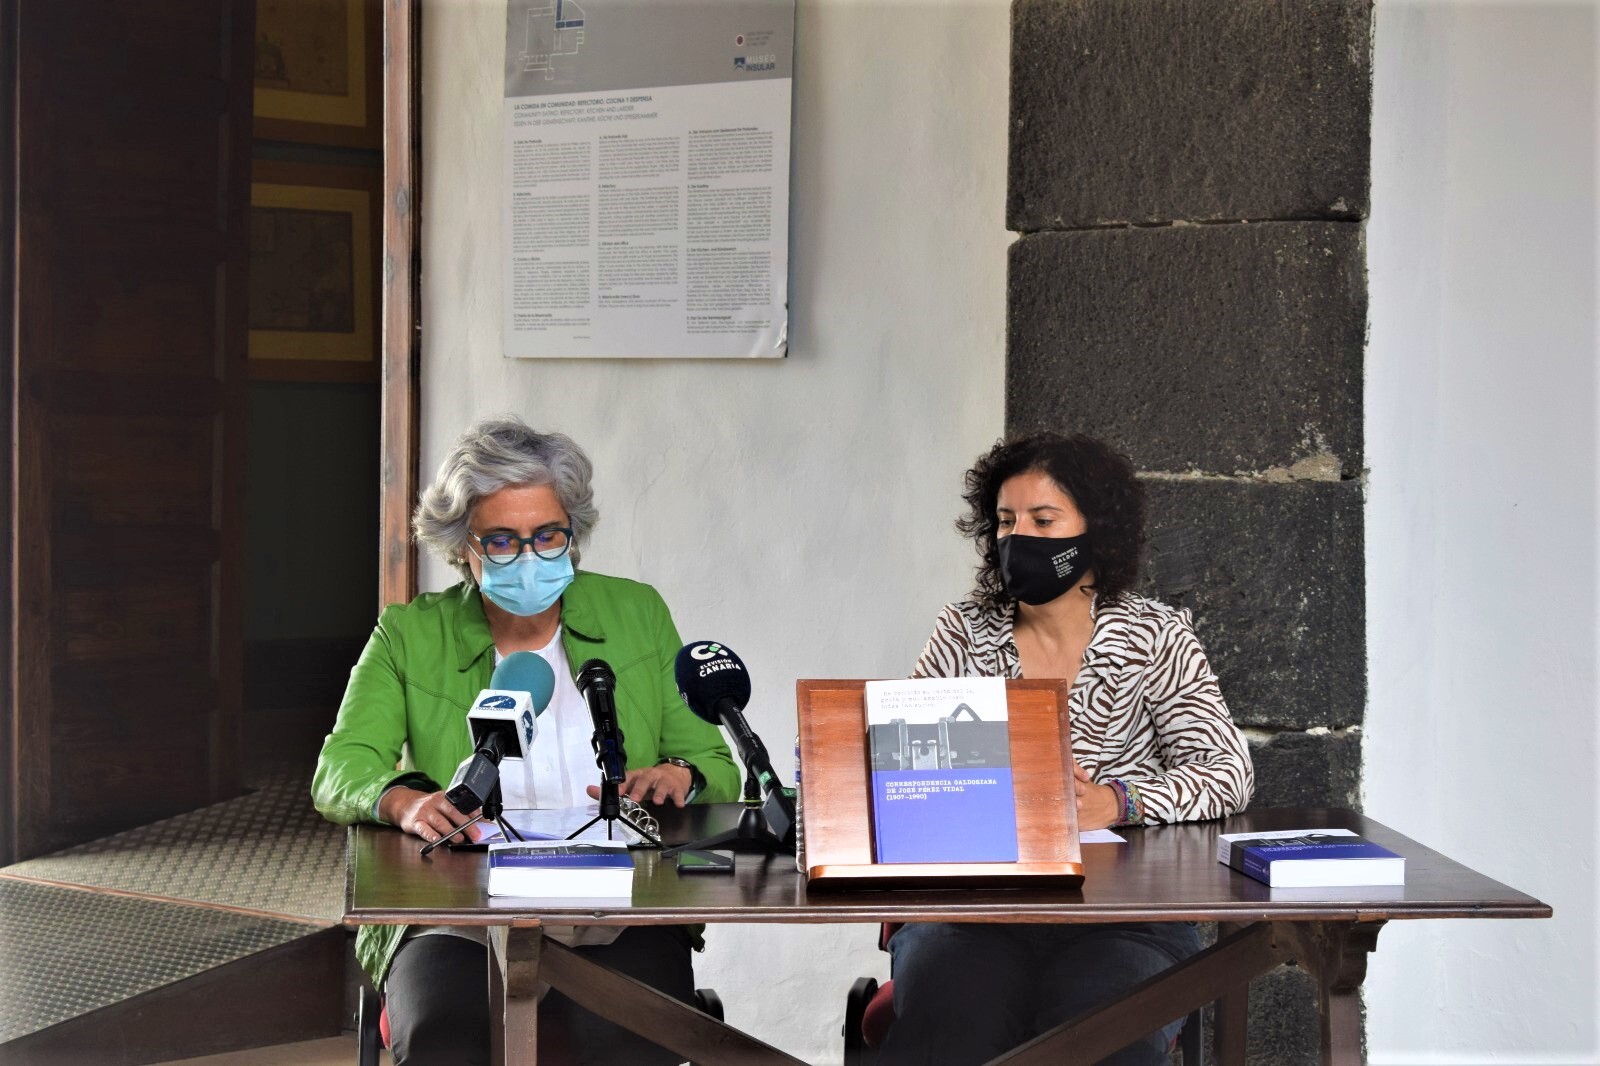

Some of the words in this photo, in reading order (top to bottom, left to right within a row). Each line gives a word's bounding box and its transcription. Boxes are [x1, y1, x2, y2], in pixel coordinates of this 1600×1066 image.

[746, 54, 776, 64] MUSEO
[746, 63, 775, 71] INSULAR
[700, 658, 732, 670] ELEVISIÓN
[700, 663, 742, 677] CANARIA
